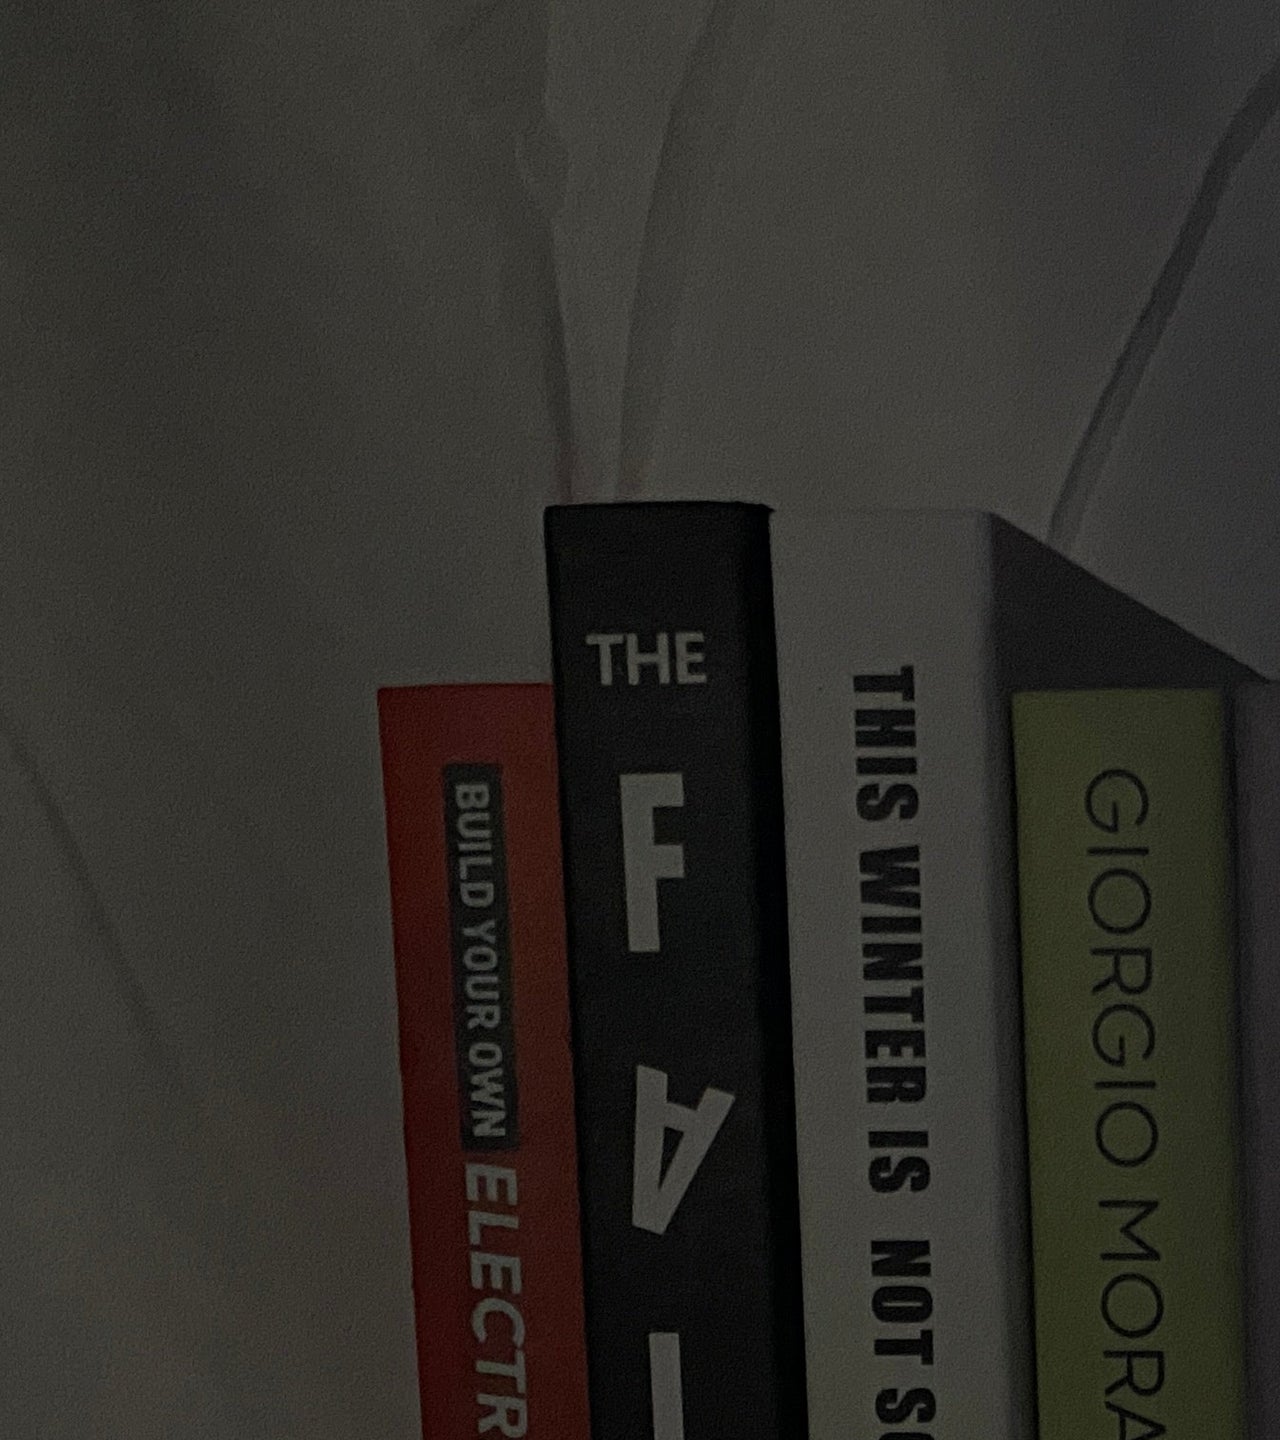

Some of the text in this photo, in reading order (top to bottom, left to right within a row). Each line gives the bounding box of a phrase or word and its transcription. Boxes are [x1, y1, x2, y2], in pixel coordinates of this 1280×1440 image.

[585, 631, 707, 686] THE
[853, 665, 919, 822] THIS
[453, 780, 495, 905] BUILD
[459, 915, 501, 1030] YOUR
[858, 845, 929, 1105] WINTER
[1084, 769, 1158, 1168] GIORGIO
[465, 1040, 507, 1139] OWN
[867, 1130, 931, 1194] IS
[871, 1240, 934, 1366] NOT
